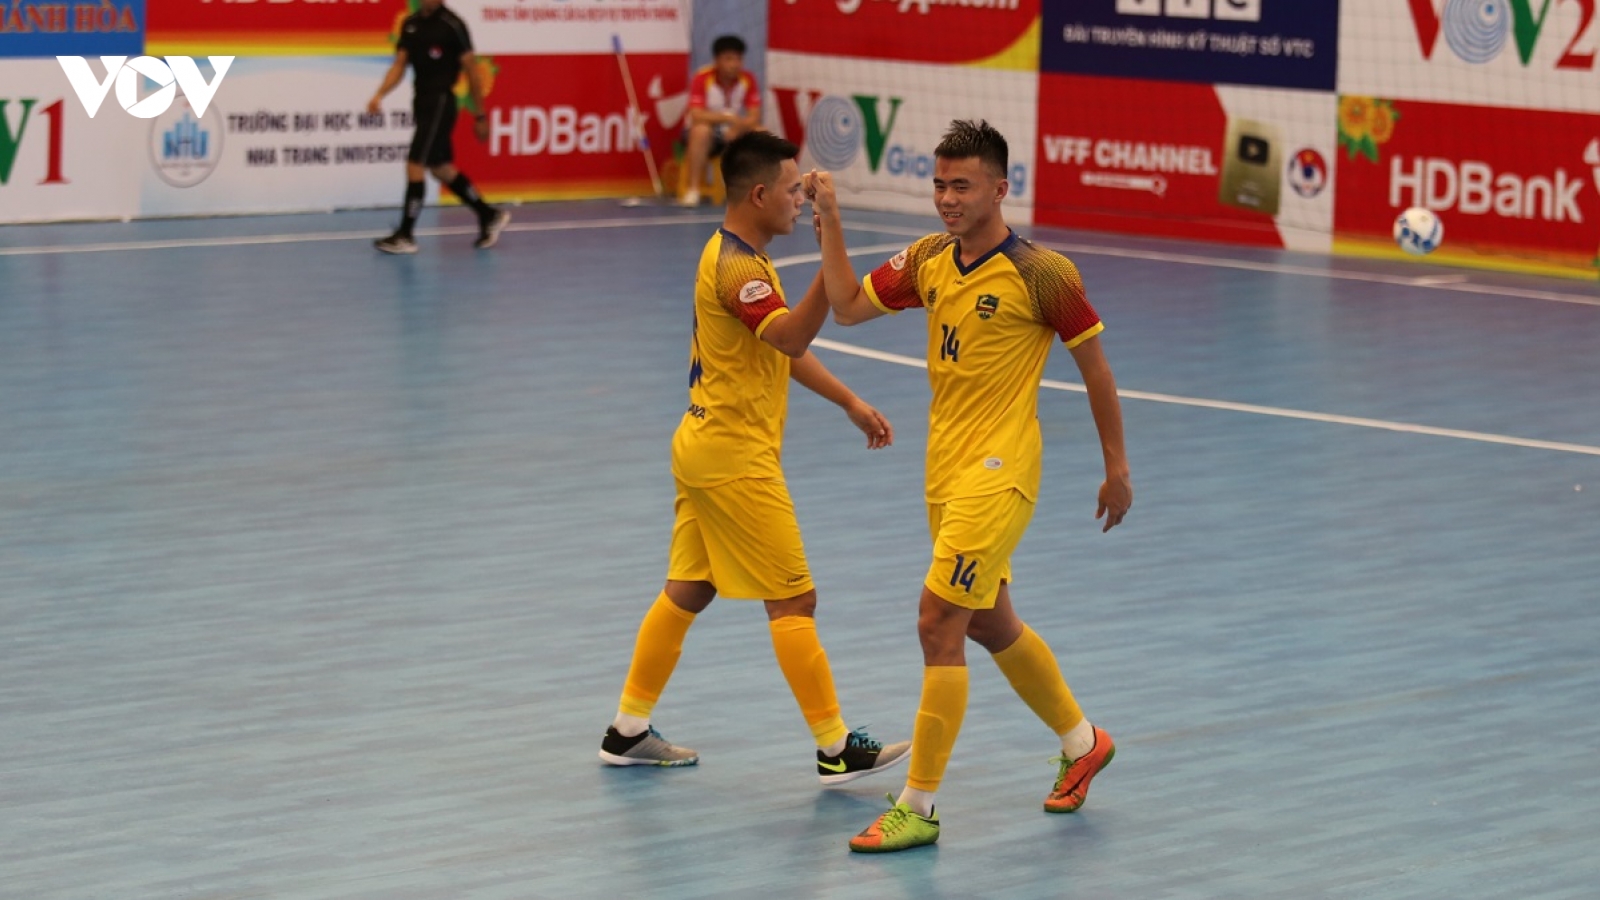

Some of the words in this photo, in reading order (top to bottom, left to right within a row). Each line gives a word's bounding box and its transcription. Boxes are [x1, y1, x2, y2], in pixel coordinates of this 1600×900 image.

[1283, 38, 1315, 58] VTC
[489, 106, 648, 156] HDBank
[282, 146, 330, 166] TRANG
[1042, 135, 1091, 165] VFF
[1094, 139, 1219, 177] CHANNEL
[1389, 156, 1585, 224] HDBank
[941, 324, 960, 363] 14
[949, 553, 977, 593] 14
